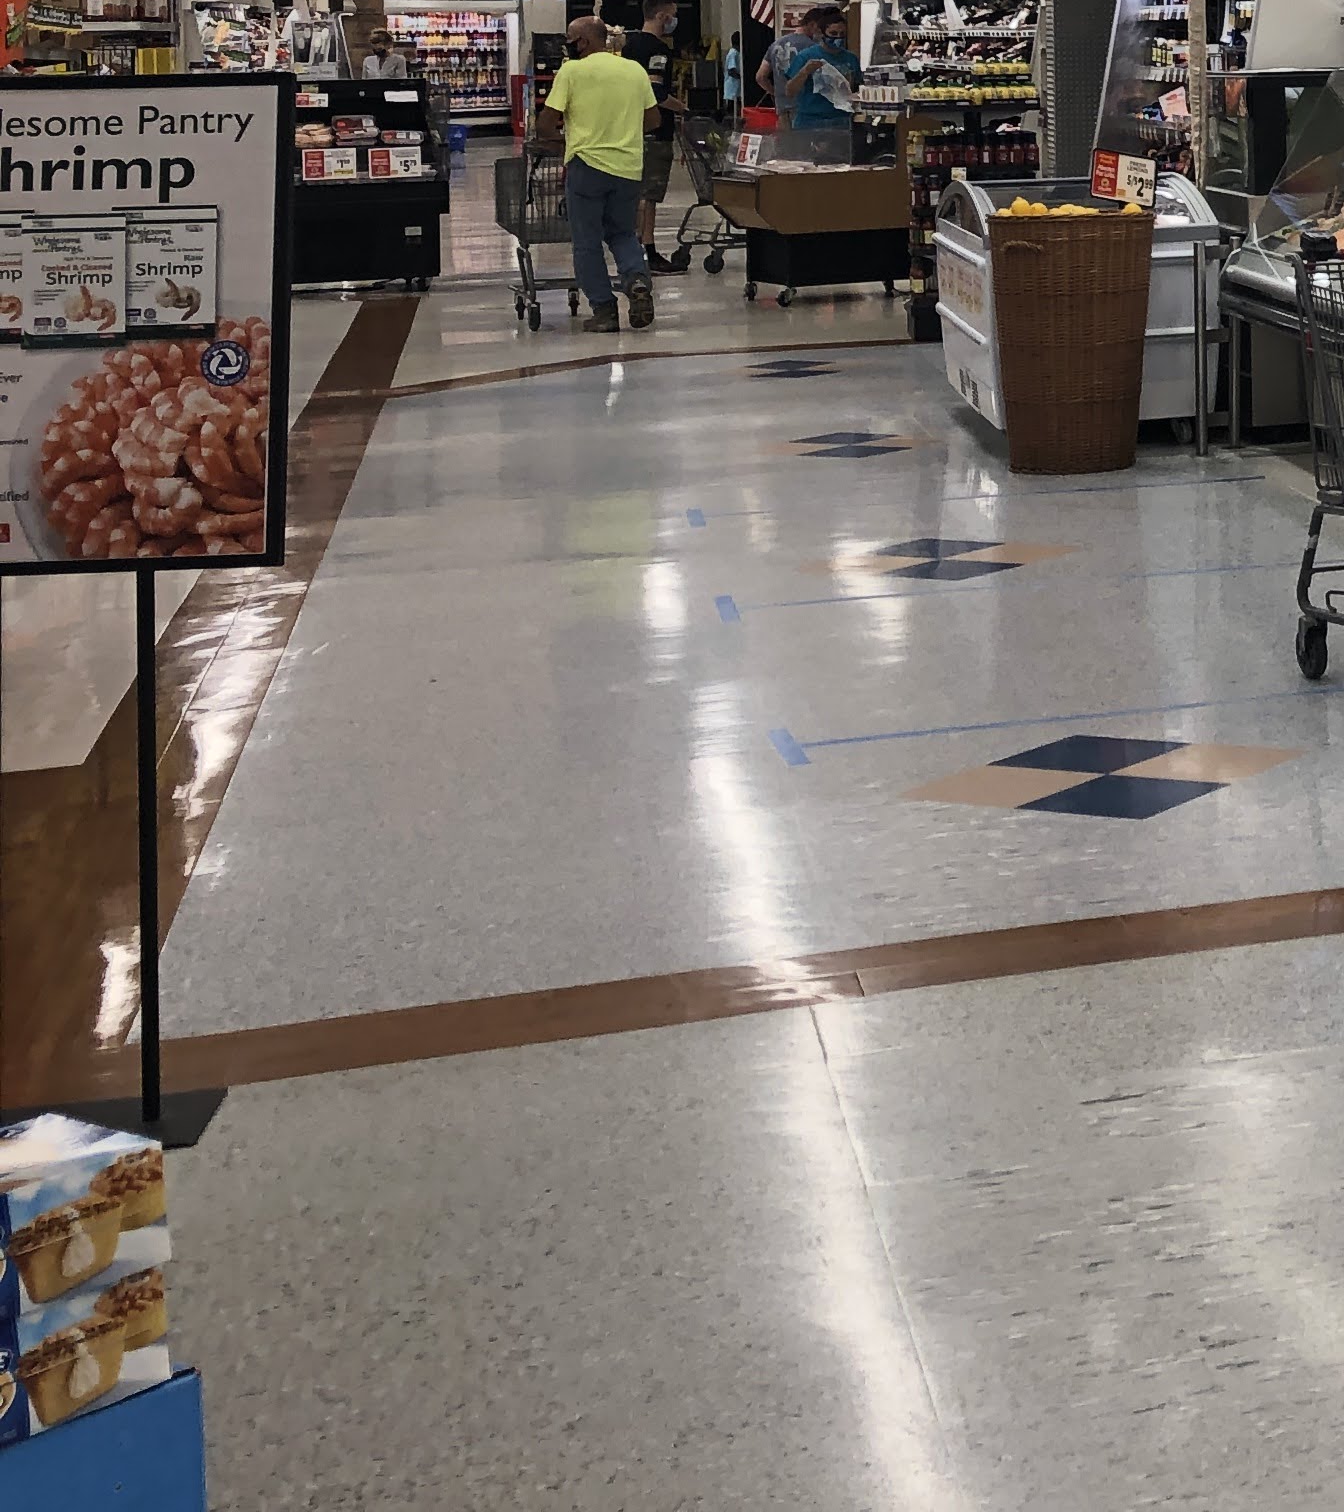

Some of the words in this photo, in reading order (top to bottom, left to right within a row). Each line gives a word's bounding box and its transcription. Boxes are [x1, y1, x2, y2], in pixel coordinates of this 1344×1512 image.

[139, 106, 254, 142] Pantry
[0, 145, 195, 203] hrimp
[46, 272, 112, 286] Shrimp
[136, 262, 202, 278] Shrimp
